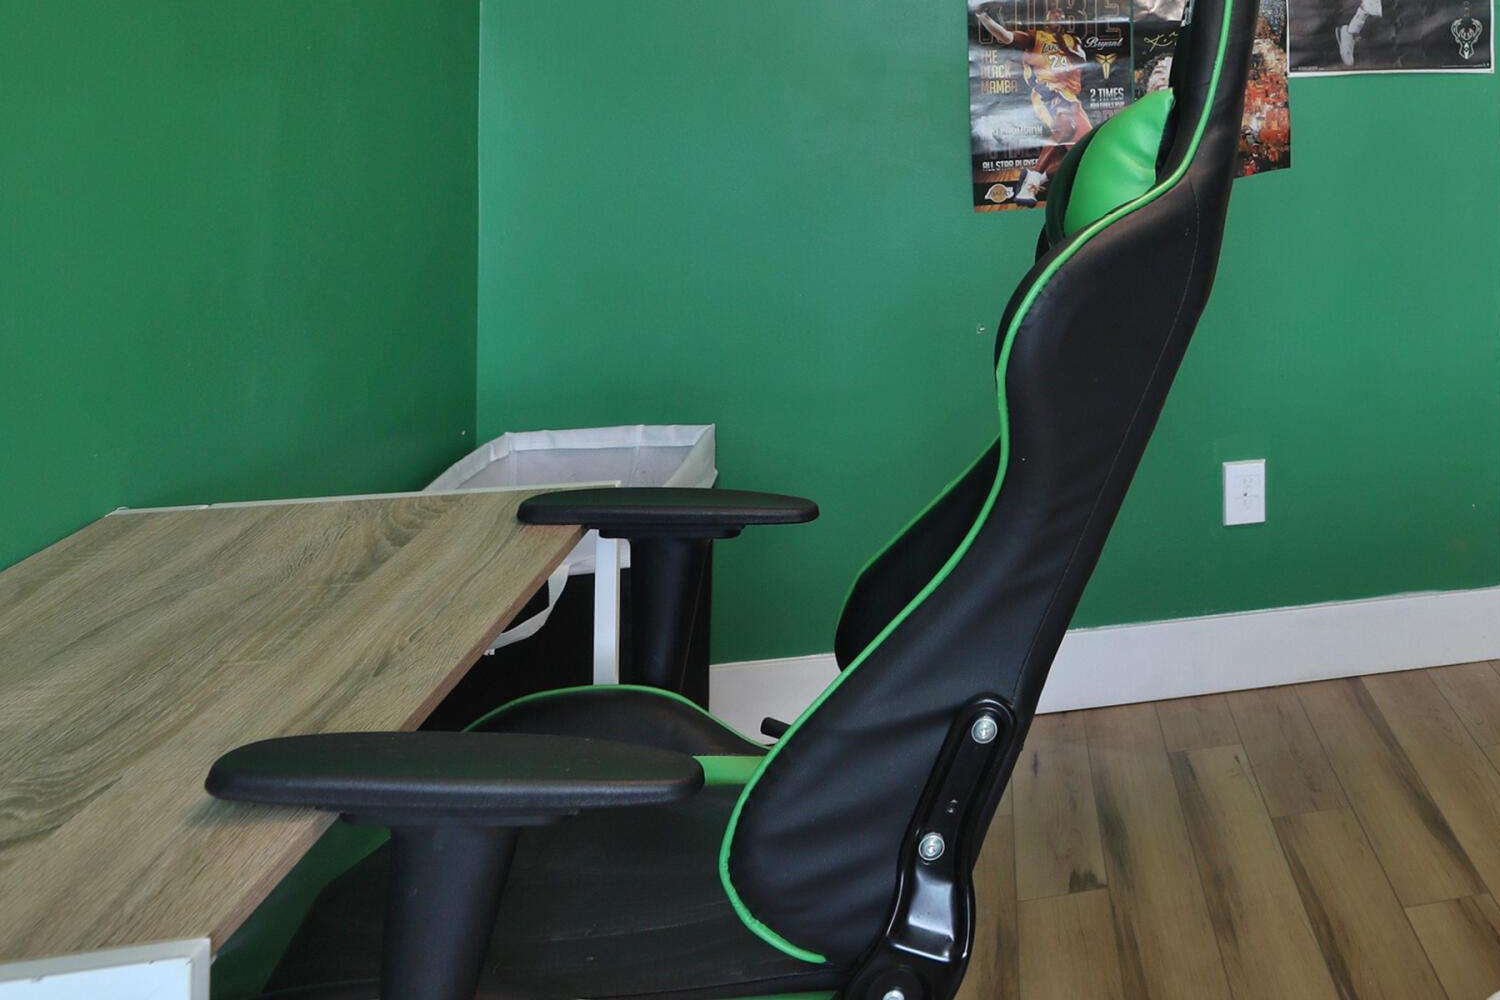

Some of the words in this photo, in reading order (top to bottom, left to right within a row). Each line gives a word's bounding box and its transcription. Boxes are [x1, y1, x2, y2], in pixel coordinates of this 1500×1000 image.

[1084, 37, 1123, 50] Bryant
[1049, 55, 1070, 72] 24
[981, 64, 1011, 79] BLACK
[981, 80, 1018, 94] MAMBA
[1090, 88, 1096, 101] 2
[1097, 87, 1124, 101] TIMES
[1015, 158, 1038, 169] PLAYE
